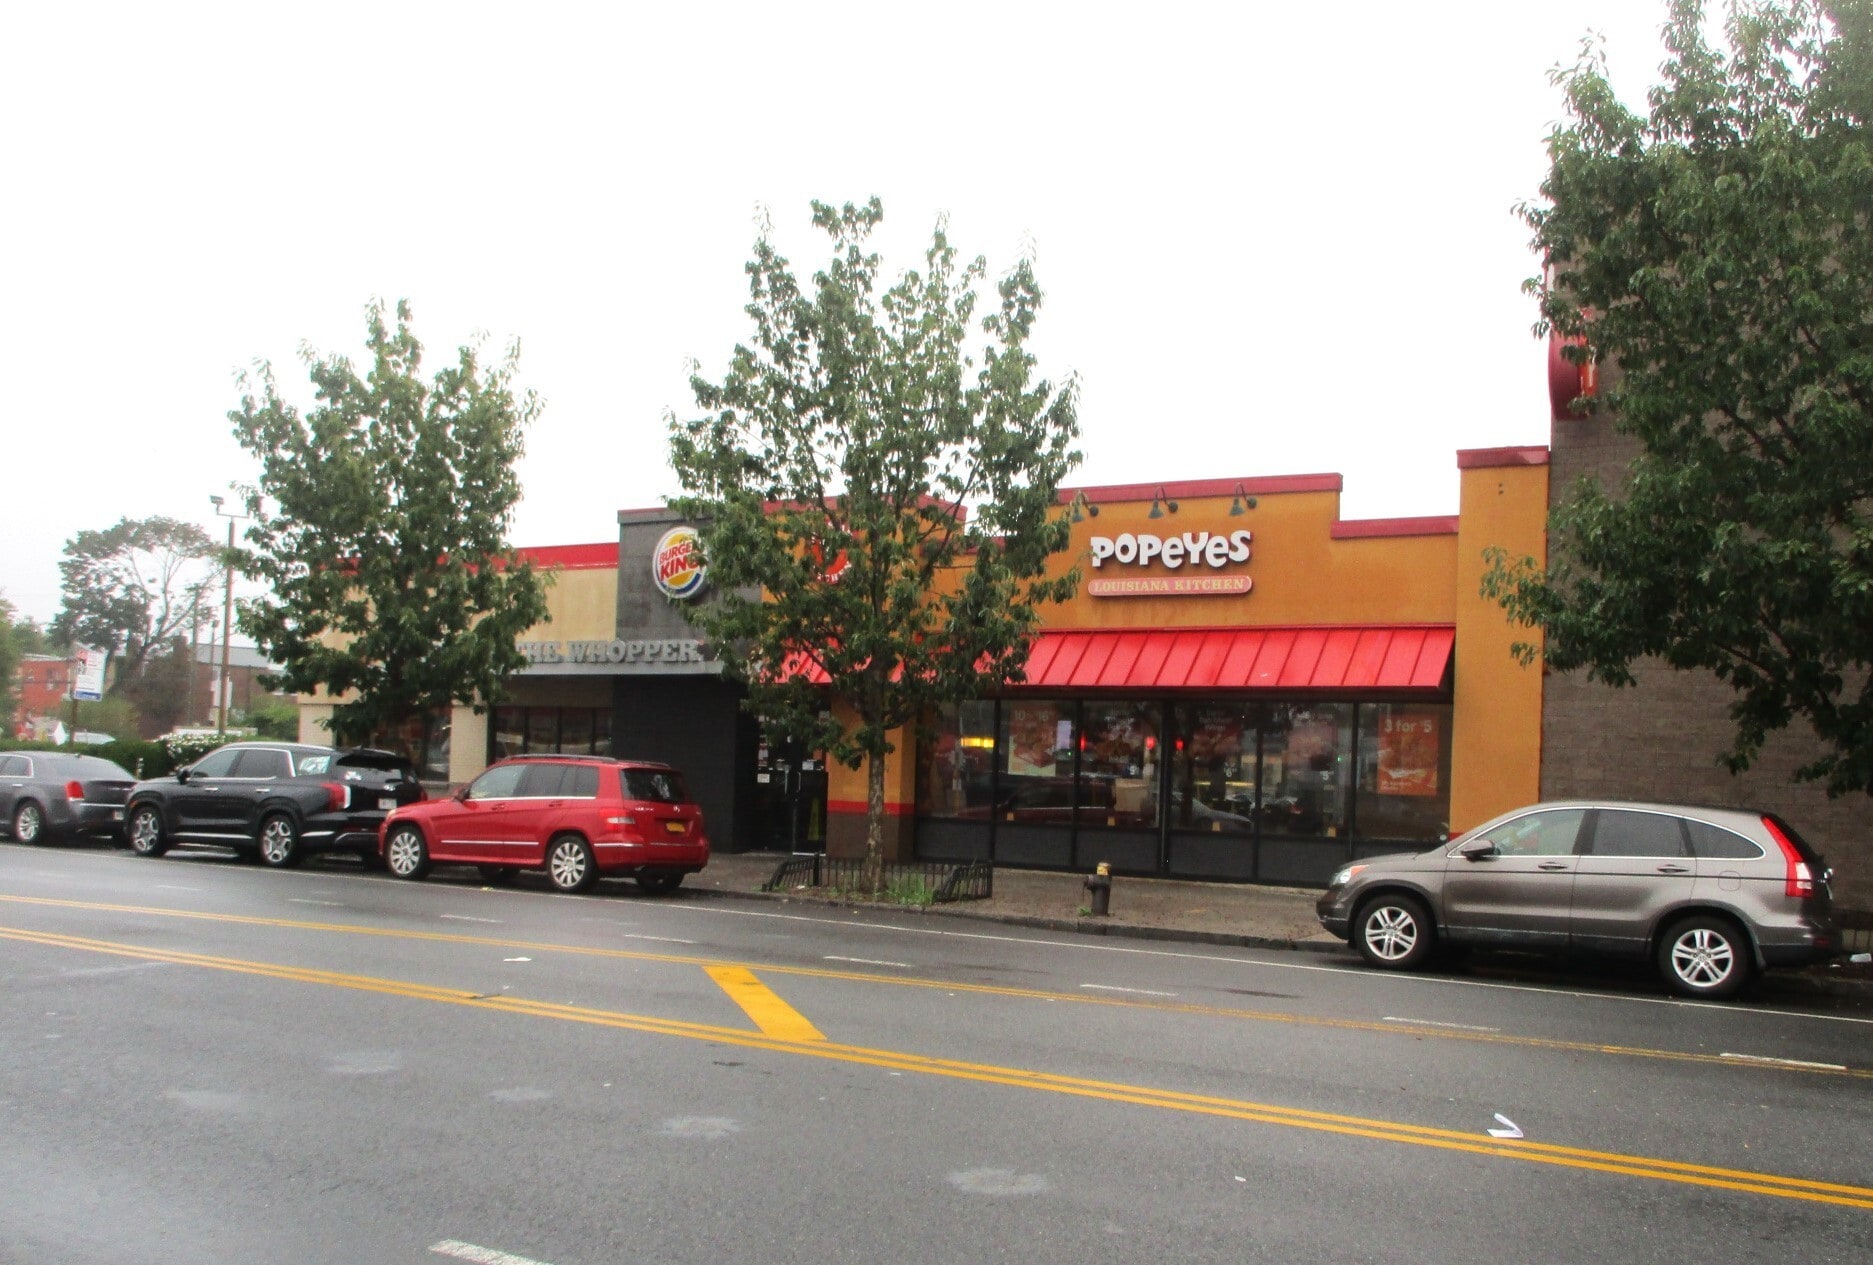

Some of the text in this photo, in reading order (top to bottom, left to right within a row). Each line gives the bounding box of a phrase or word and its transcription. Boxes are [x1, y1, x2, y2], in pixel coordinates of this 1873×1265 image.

[660, 542, 697, 563] BURGE
[1094, 578, 1246, 592] LOUISIANA KITCHEN
[516, 638, 702, 663] THE WHOPPER
[1396, 719, 1417, 733] for
